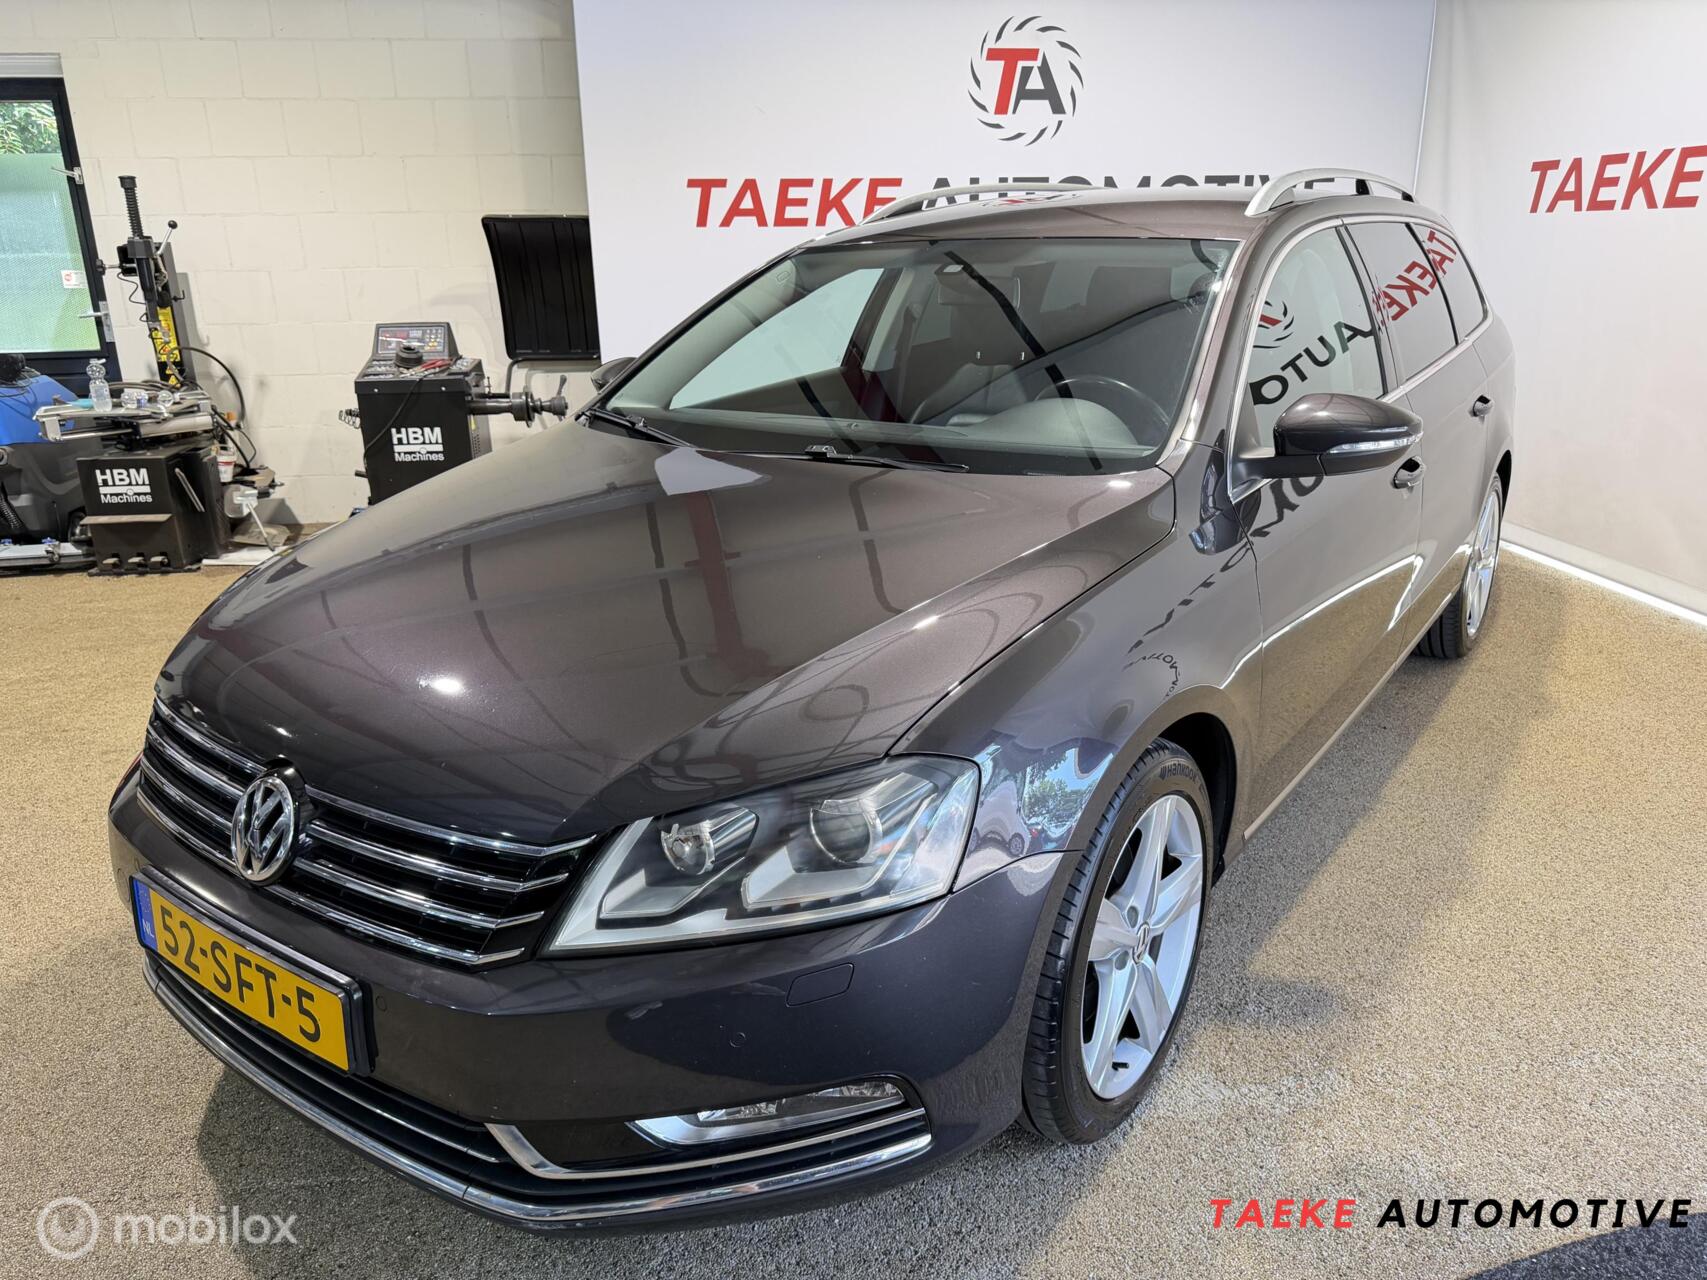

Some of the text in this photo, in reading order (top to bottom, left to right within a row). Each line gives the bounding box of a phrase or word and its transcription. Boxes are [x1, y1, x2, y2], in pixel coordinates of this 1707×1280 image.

[986, 48, 1066, 115] TA
[1529, 145, 1707, 214] TAEKE
[686, 177, 903, 228] TAEKE
[391, 427, 443, 444] HBM
[394, 451, 445, 462] Machines
[95, 468, 150, 486] HBM
[100, 493, 153, 504] Machines
[142, 918, 155, 938] NL
[160, 905, 321, 1043] 52-SFT-5
